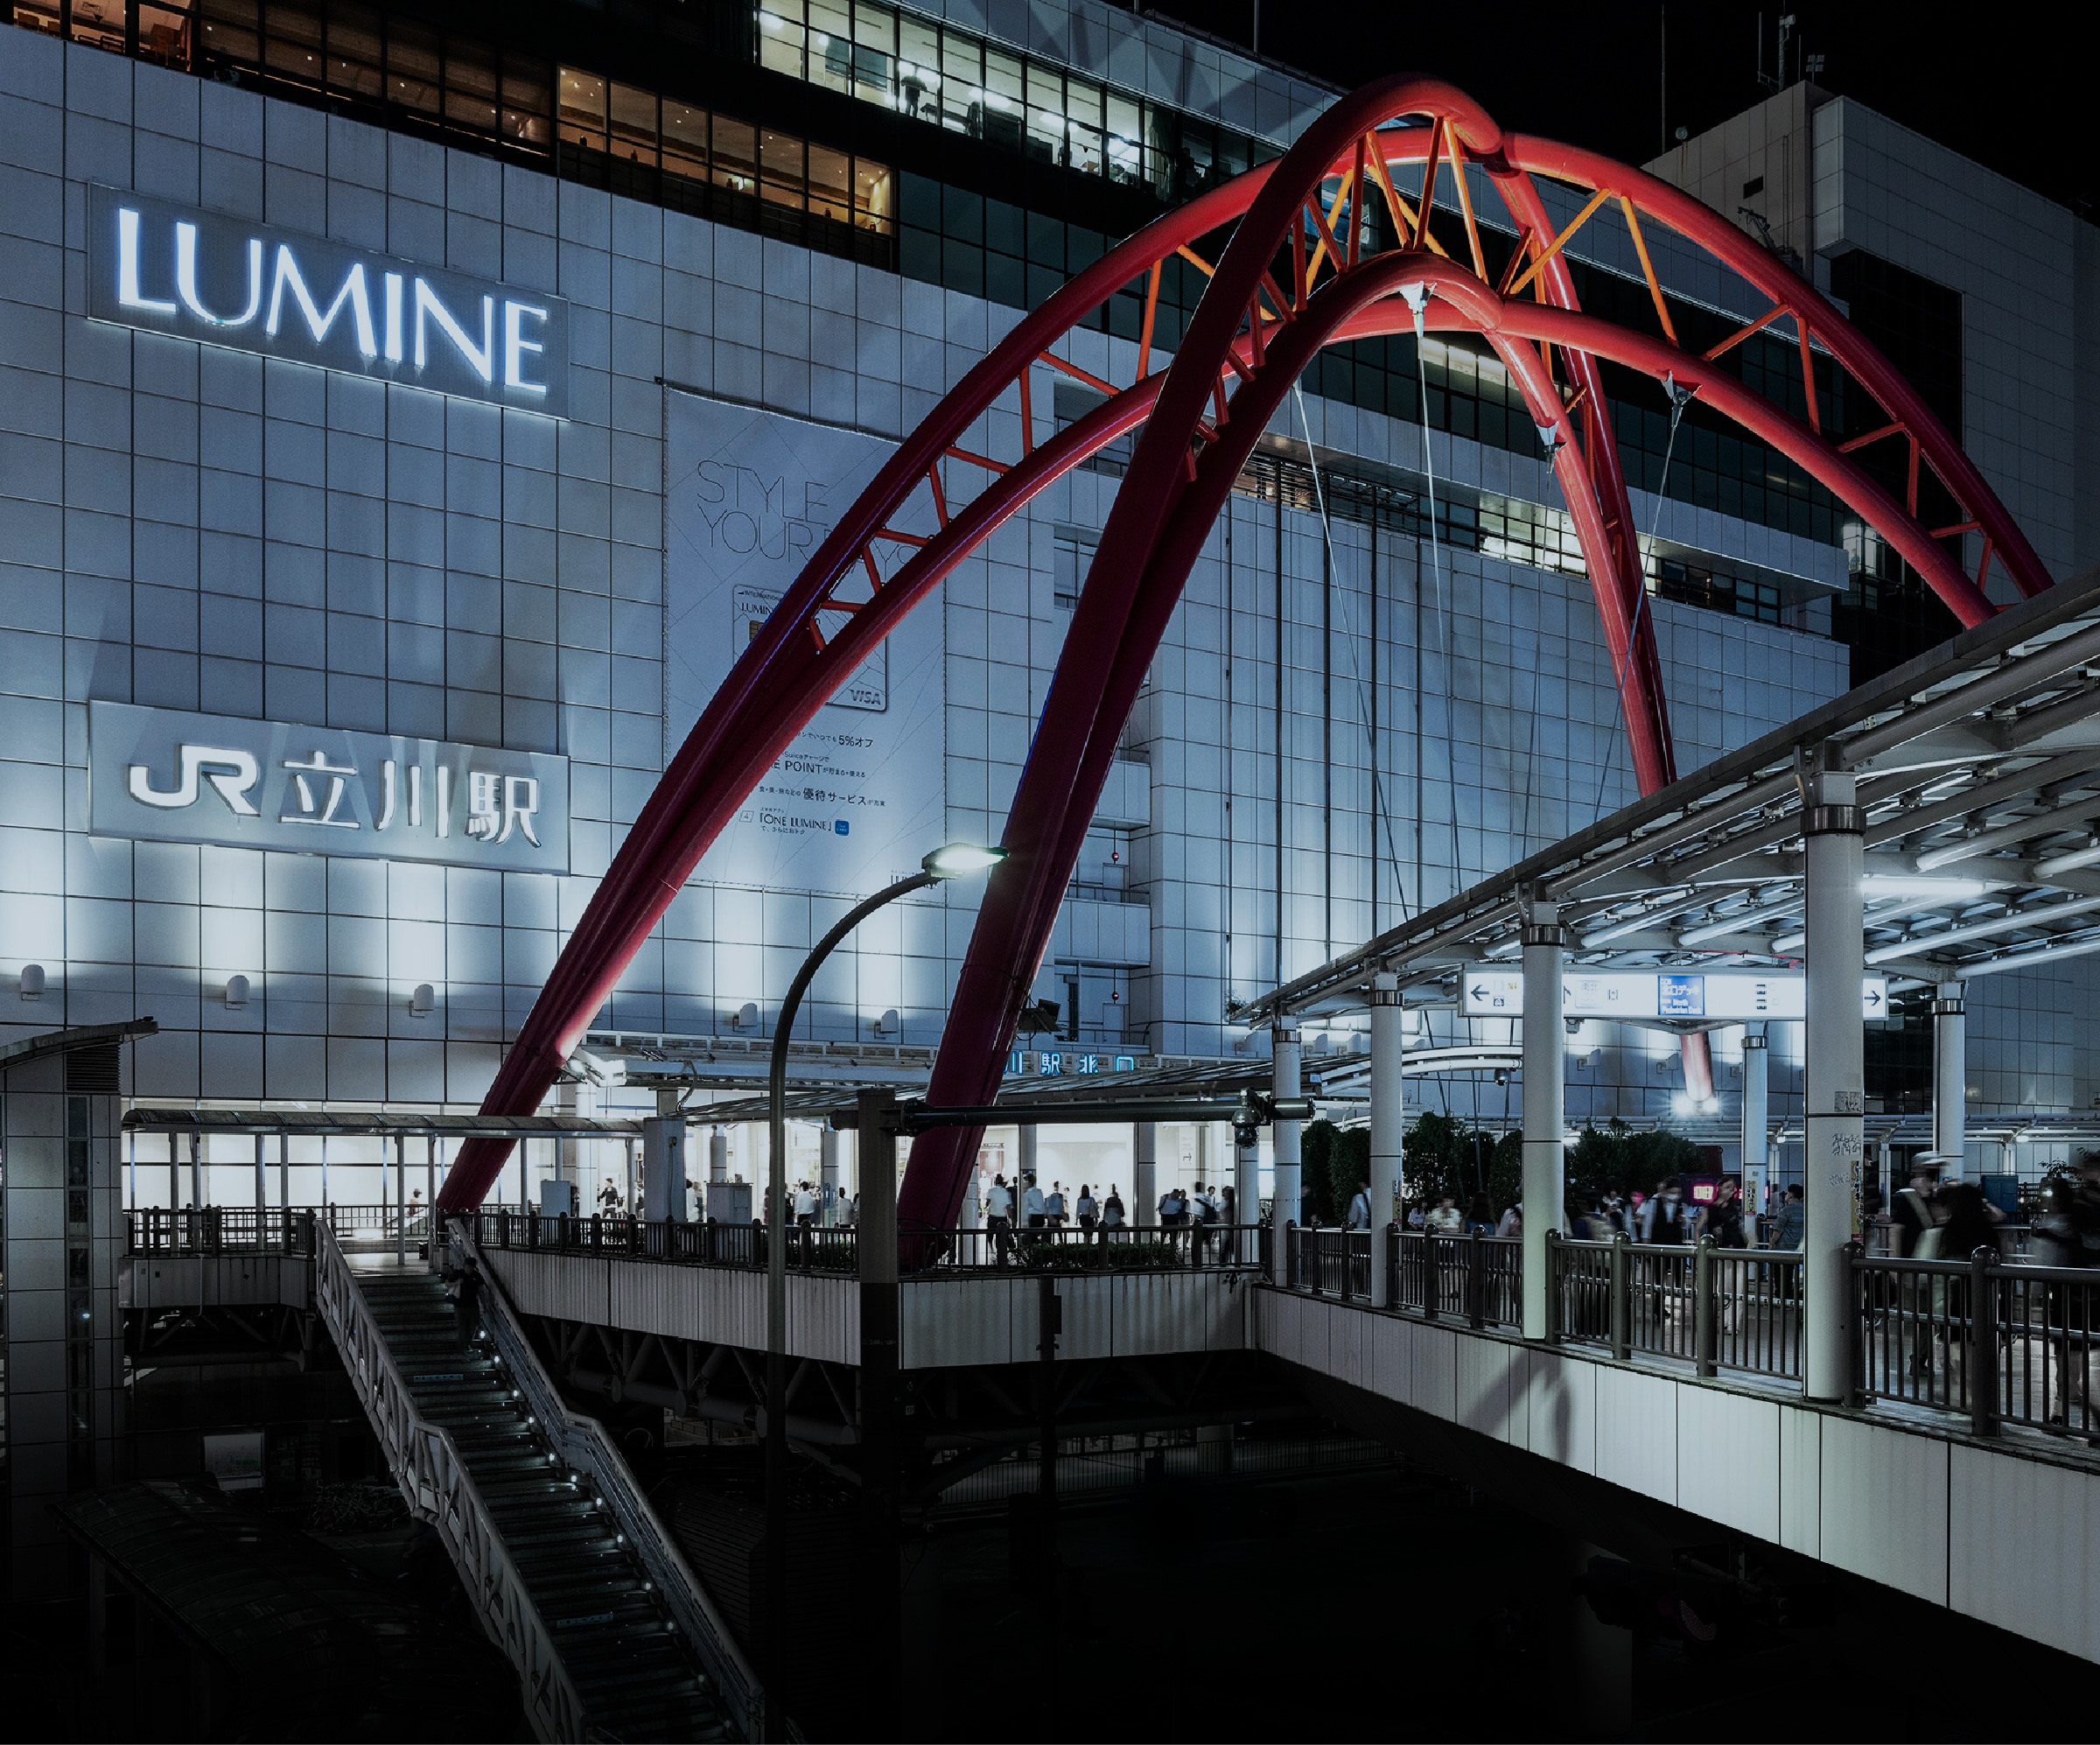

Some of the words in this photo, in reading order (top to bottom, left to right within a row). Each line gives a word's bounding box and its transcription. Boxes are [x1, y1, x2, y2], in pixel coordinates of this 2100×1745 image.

[119, 207, 548, 394] LUMINE
[697, 459, 828, 527] STYLE
[697, 503, 813, 563] YOUR
[741, 602, 774, 614] LUMIN
[849, 689, 881, 705] VISA
